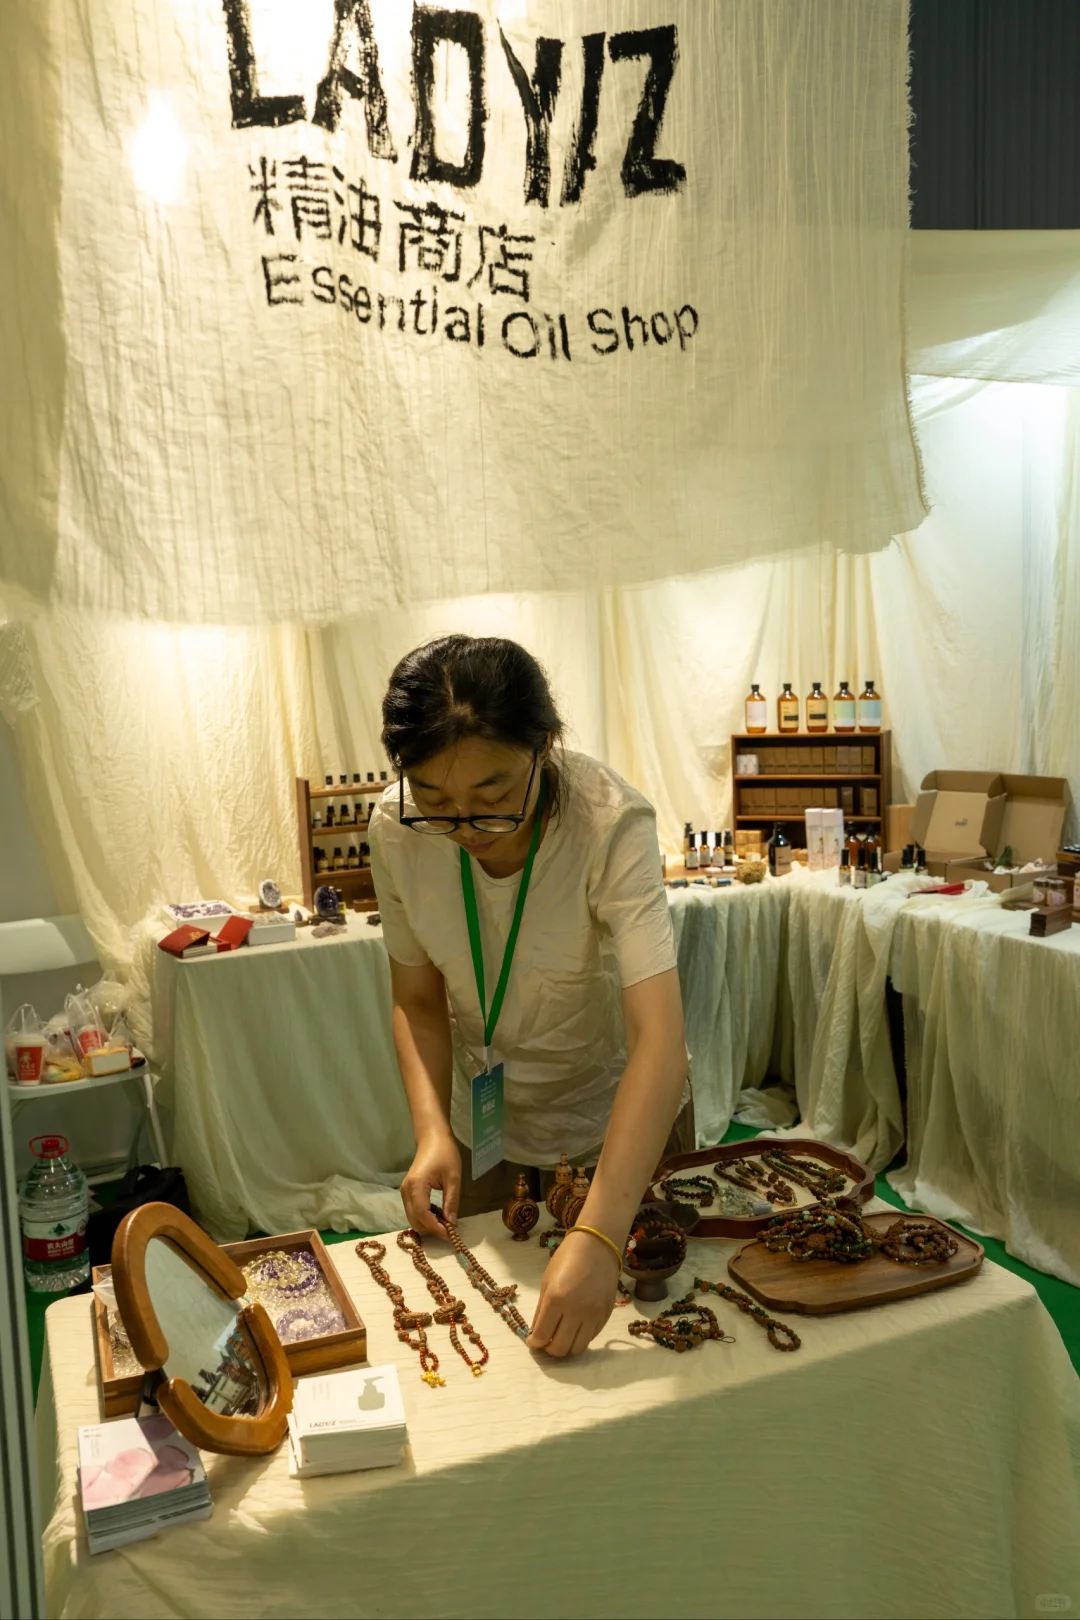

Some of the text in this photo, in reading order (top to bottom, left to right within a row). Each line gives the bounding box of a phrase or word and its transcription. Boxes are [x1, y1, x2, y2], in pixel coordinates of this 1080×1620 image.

[248, 155, 536, 302] 精油商店
[261, 253, 699, 361] Essential Oil Shop
